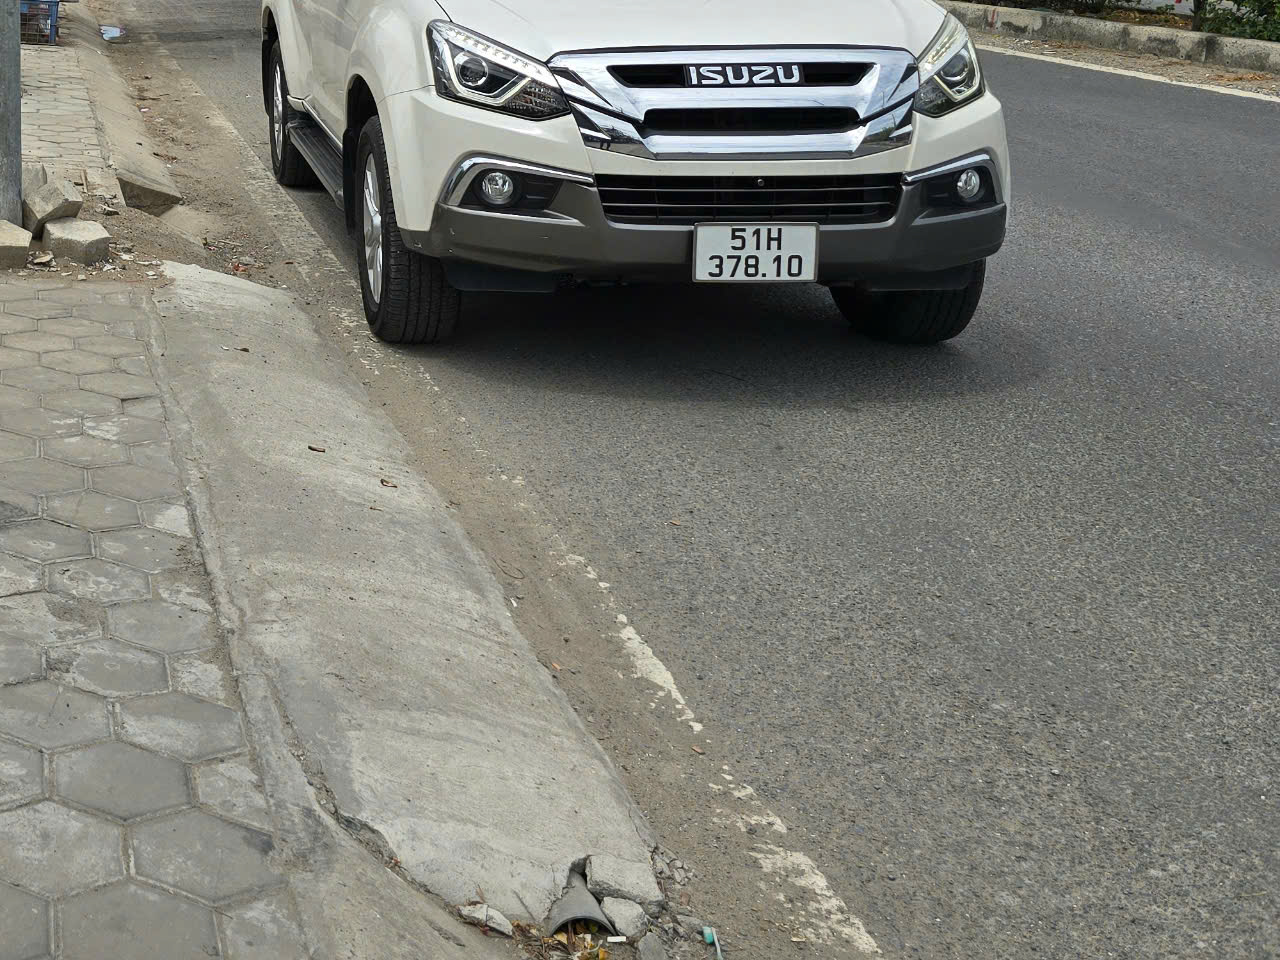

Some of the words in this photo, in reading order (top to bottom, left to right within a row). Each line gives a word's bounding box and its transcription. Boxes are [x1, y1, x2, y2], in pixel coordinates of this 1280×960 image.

[688, 64, 800, 85] ISUZU
[730, 227, 782, 251] 51H
[708, 254, 803, 278] 378.10
